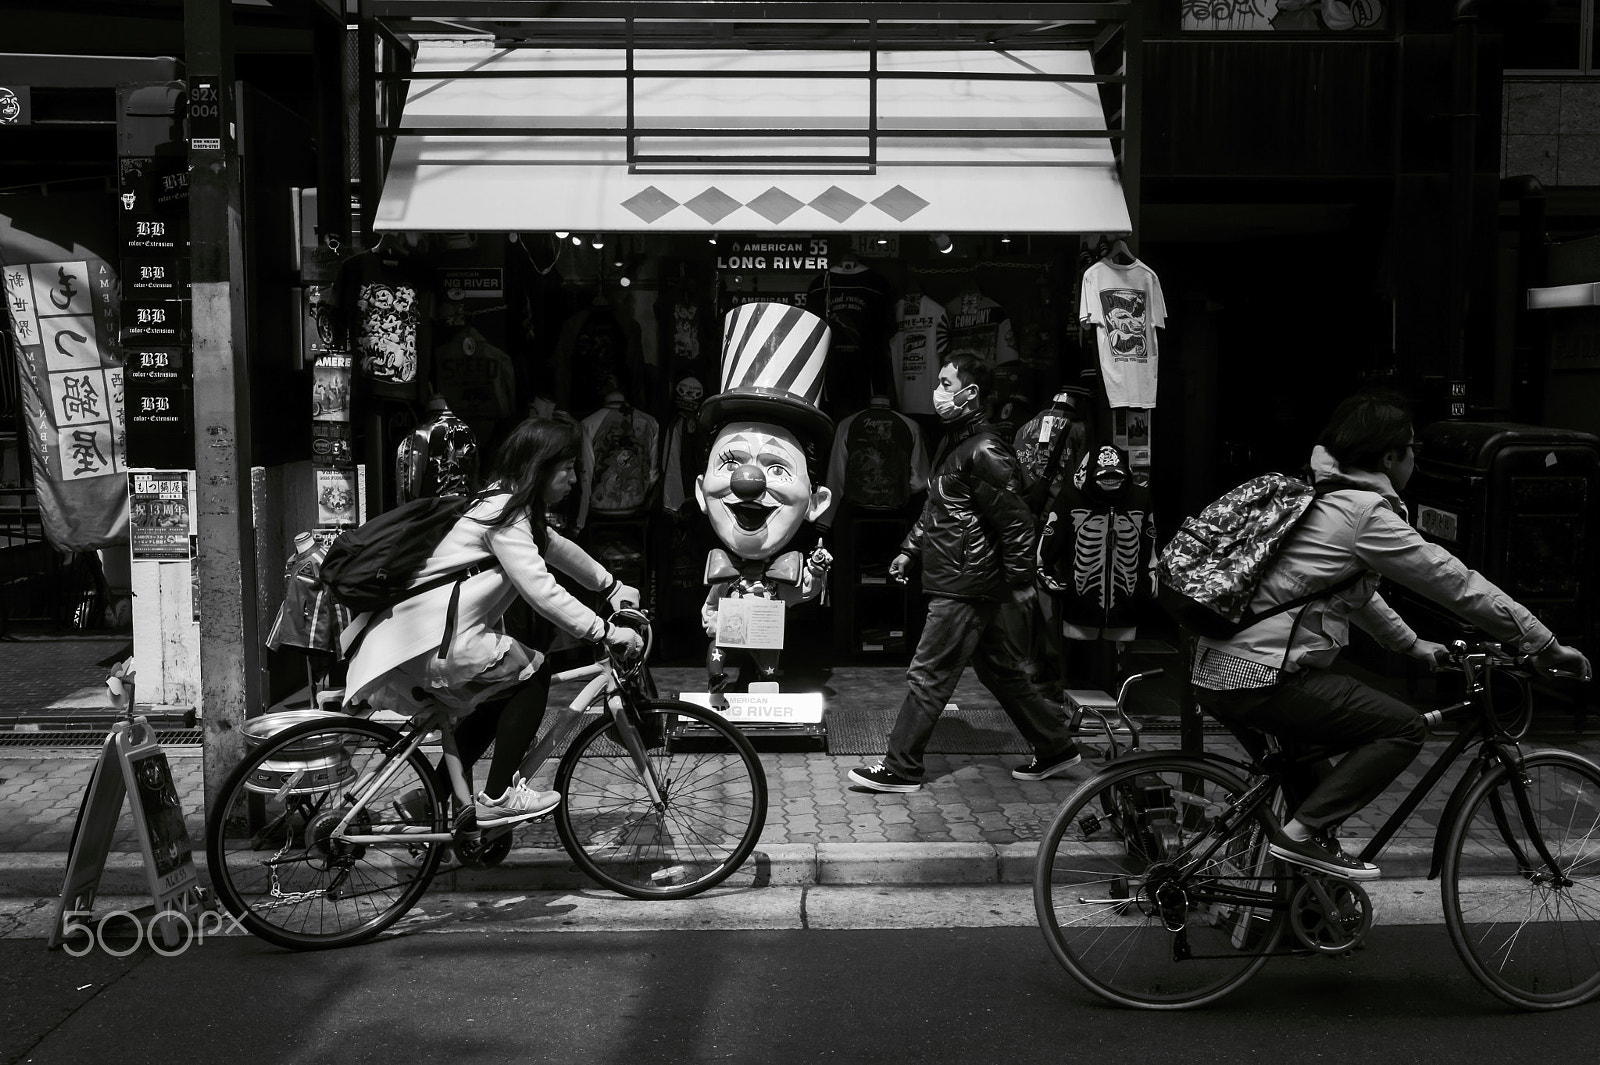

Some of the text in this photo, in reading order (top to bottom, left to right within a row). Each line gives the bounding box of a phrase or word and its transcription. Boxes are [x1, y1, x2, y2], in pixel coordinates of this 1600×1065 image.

[191, 88, 218, 101] 92X
[191, 104, 218, 118] 004
[136, 221, 165, 237] BB
[743, 239, 828, 256] AMERICAN 55
[717, 256, 828, 270] LONG RIVER
[140, 266, 165, 280] BB
[464, 278, 499, 288] RIVER
[741, 296, 788, 304] AMERICAN
[137, 308, 166, 324] BB
[140, 352, 169, 367] BB
[140, 396, 170, 411] BB
[747, 706, 793, 717] RIVER
